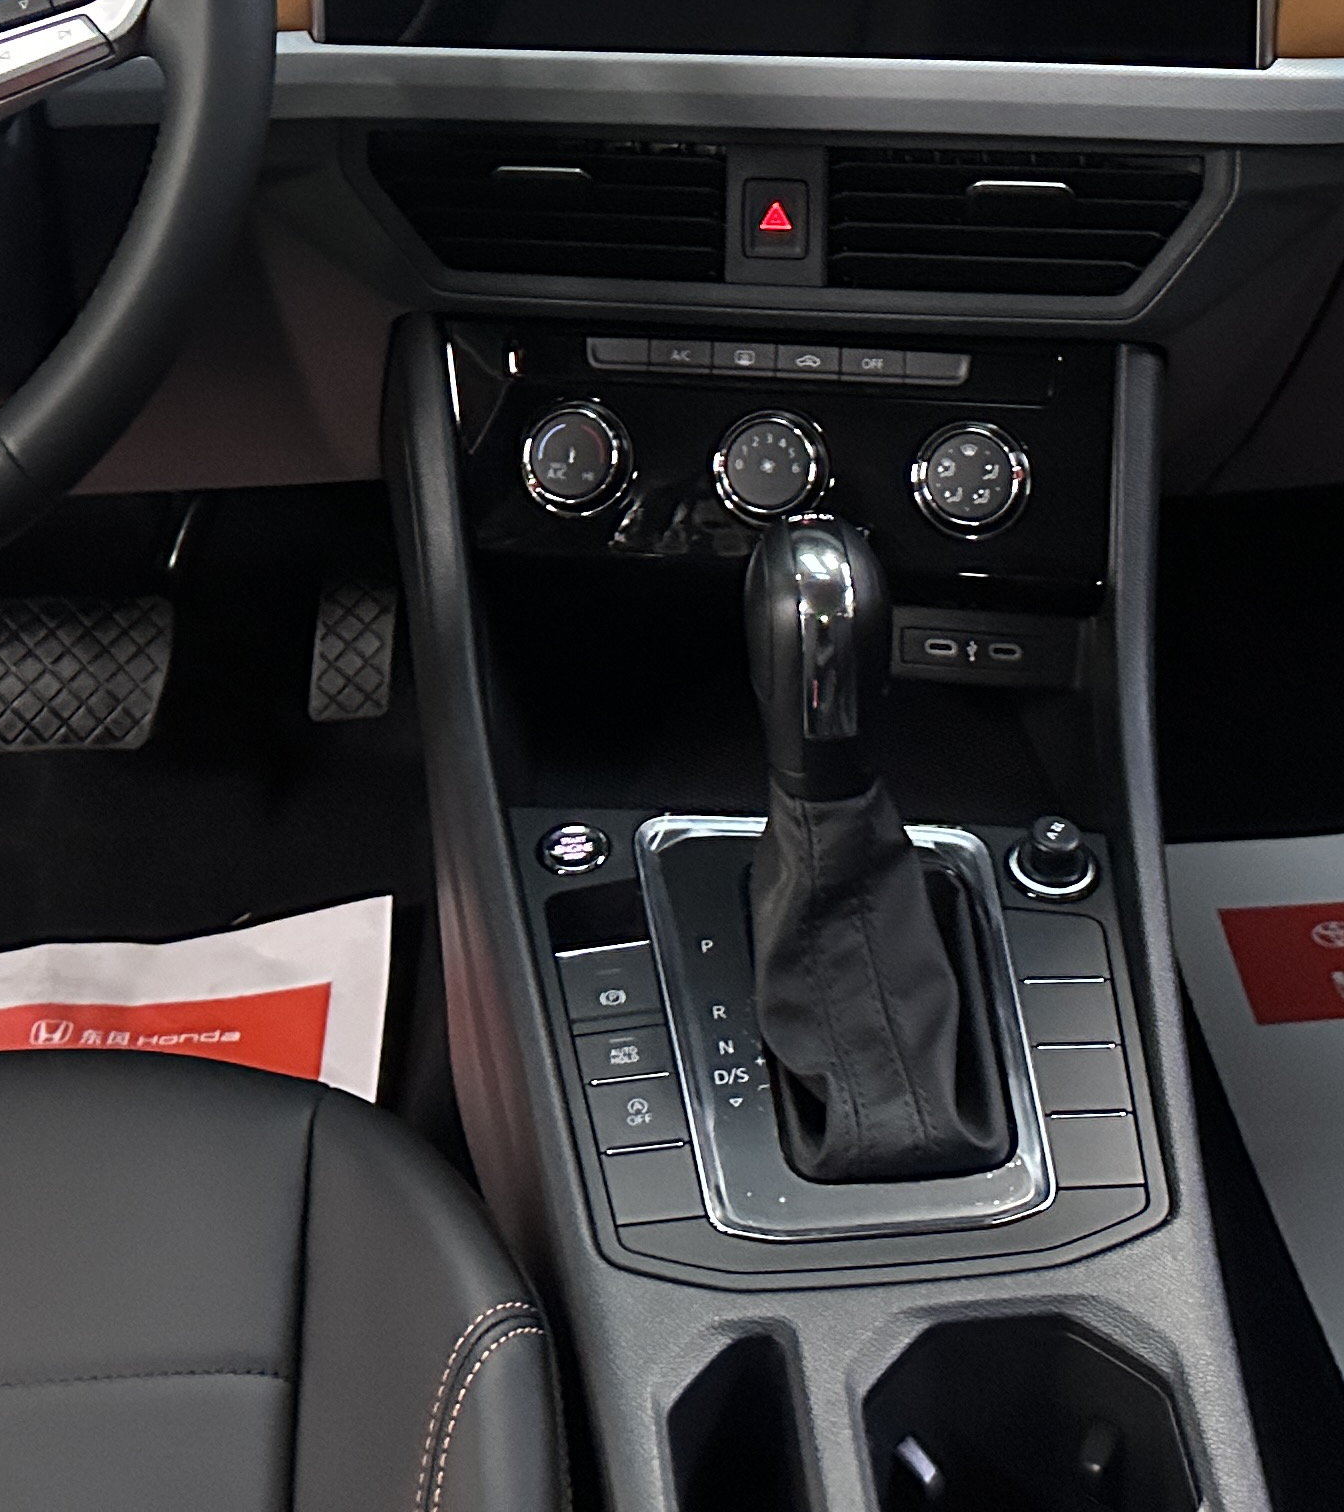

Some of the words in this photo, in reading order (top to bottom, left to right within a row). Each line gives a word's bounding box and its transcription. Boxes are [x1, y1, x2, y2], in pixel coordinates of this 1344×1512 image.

[860, 358, 884, 370] OFF
[700, 939, 714, 954] P
[712, 1005, 727, 1020] R
[609, 1044, 639, 1056] AUTO
[718, 1040, 735, 1056] N
[609, 1054, 640, 1065] HOLD
[713, 1067, 750, 1086] D/S
[626, 1112, 653, 1127] OFF
